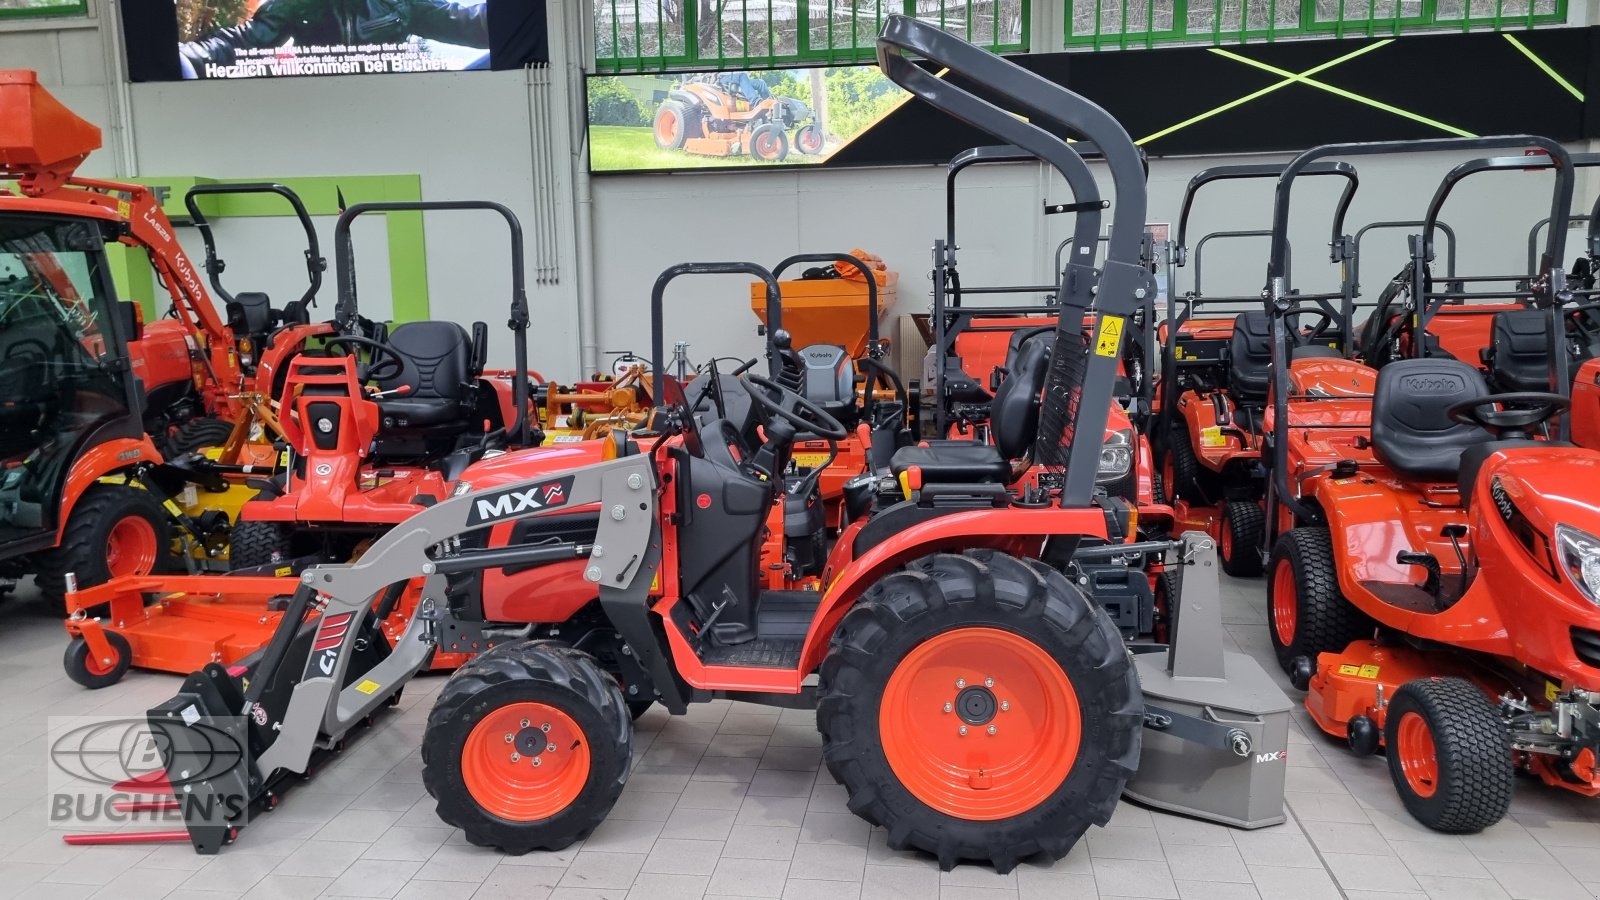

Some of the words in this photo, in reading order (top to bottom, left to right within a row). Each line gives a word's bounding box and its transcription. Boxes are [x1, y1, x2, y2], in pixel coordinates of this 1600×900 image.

[234, 48, 248, 56] The
[249, 47, 274, 56] all-new
[303, 46, 309, 54] is
[310, 45, 330, 53] fitted
[331, 44, 347, 53] with
[358, 44, 381, 53] engine
[382, 43, 397, 51] that
[205, 62, 267, 79] Herzlich
[269, 60, 361, 76] willkommen
[364, 60, 388, 73] bei
[175, 252, 202, 301] Kubota
[1406, 378, 1457, 393] Kubota
[477, 487, 543, 520] MX
[1492, 480, 1512, 519] Kubota
[1256, 751, 1279, 763] MX
